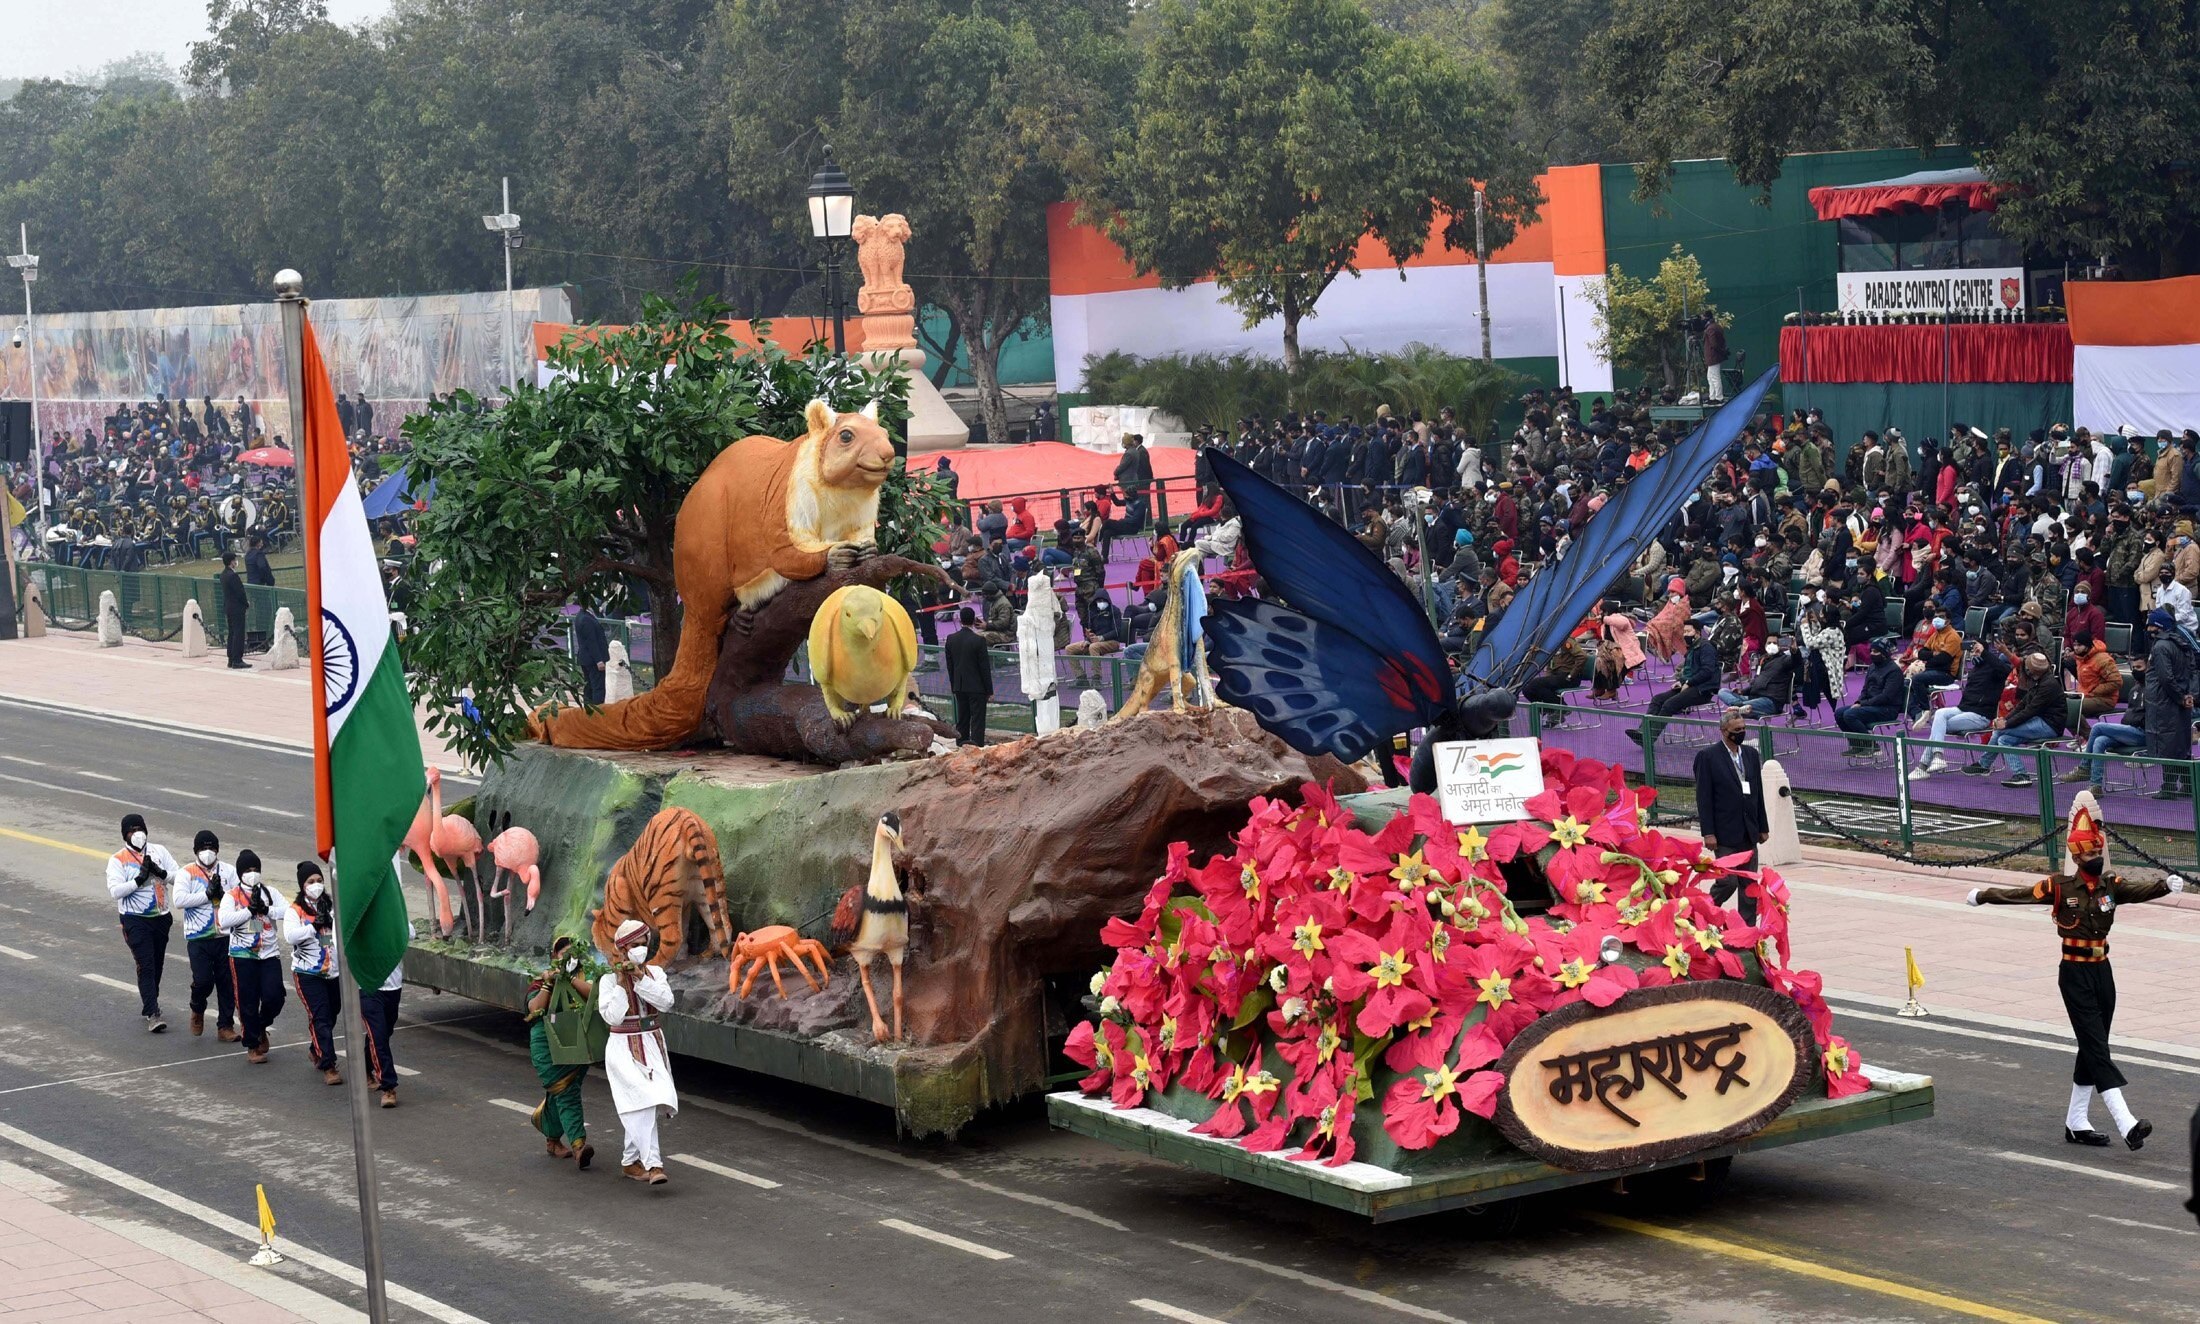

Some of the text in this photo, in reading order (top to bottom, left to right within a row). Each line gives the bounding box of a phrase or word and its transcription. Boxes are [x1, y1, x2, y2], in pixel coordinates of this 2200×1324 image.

[1865, 281, 1902, 309] PARADE
[1953, 278, 1993, 308] CENTRE
[1445, 777, 1502, 798] आज़ादी का
[1461, 798, 1491, 817] अमृत
[1540, 1022, 1753, 1127] महाराष्ट्र
